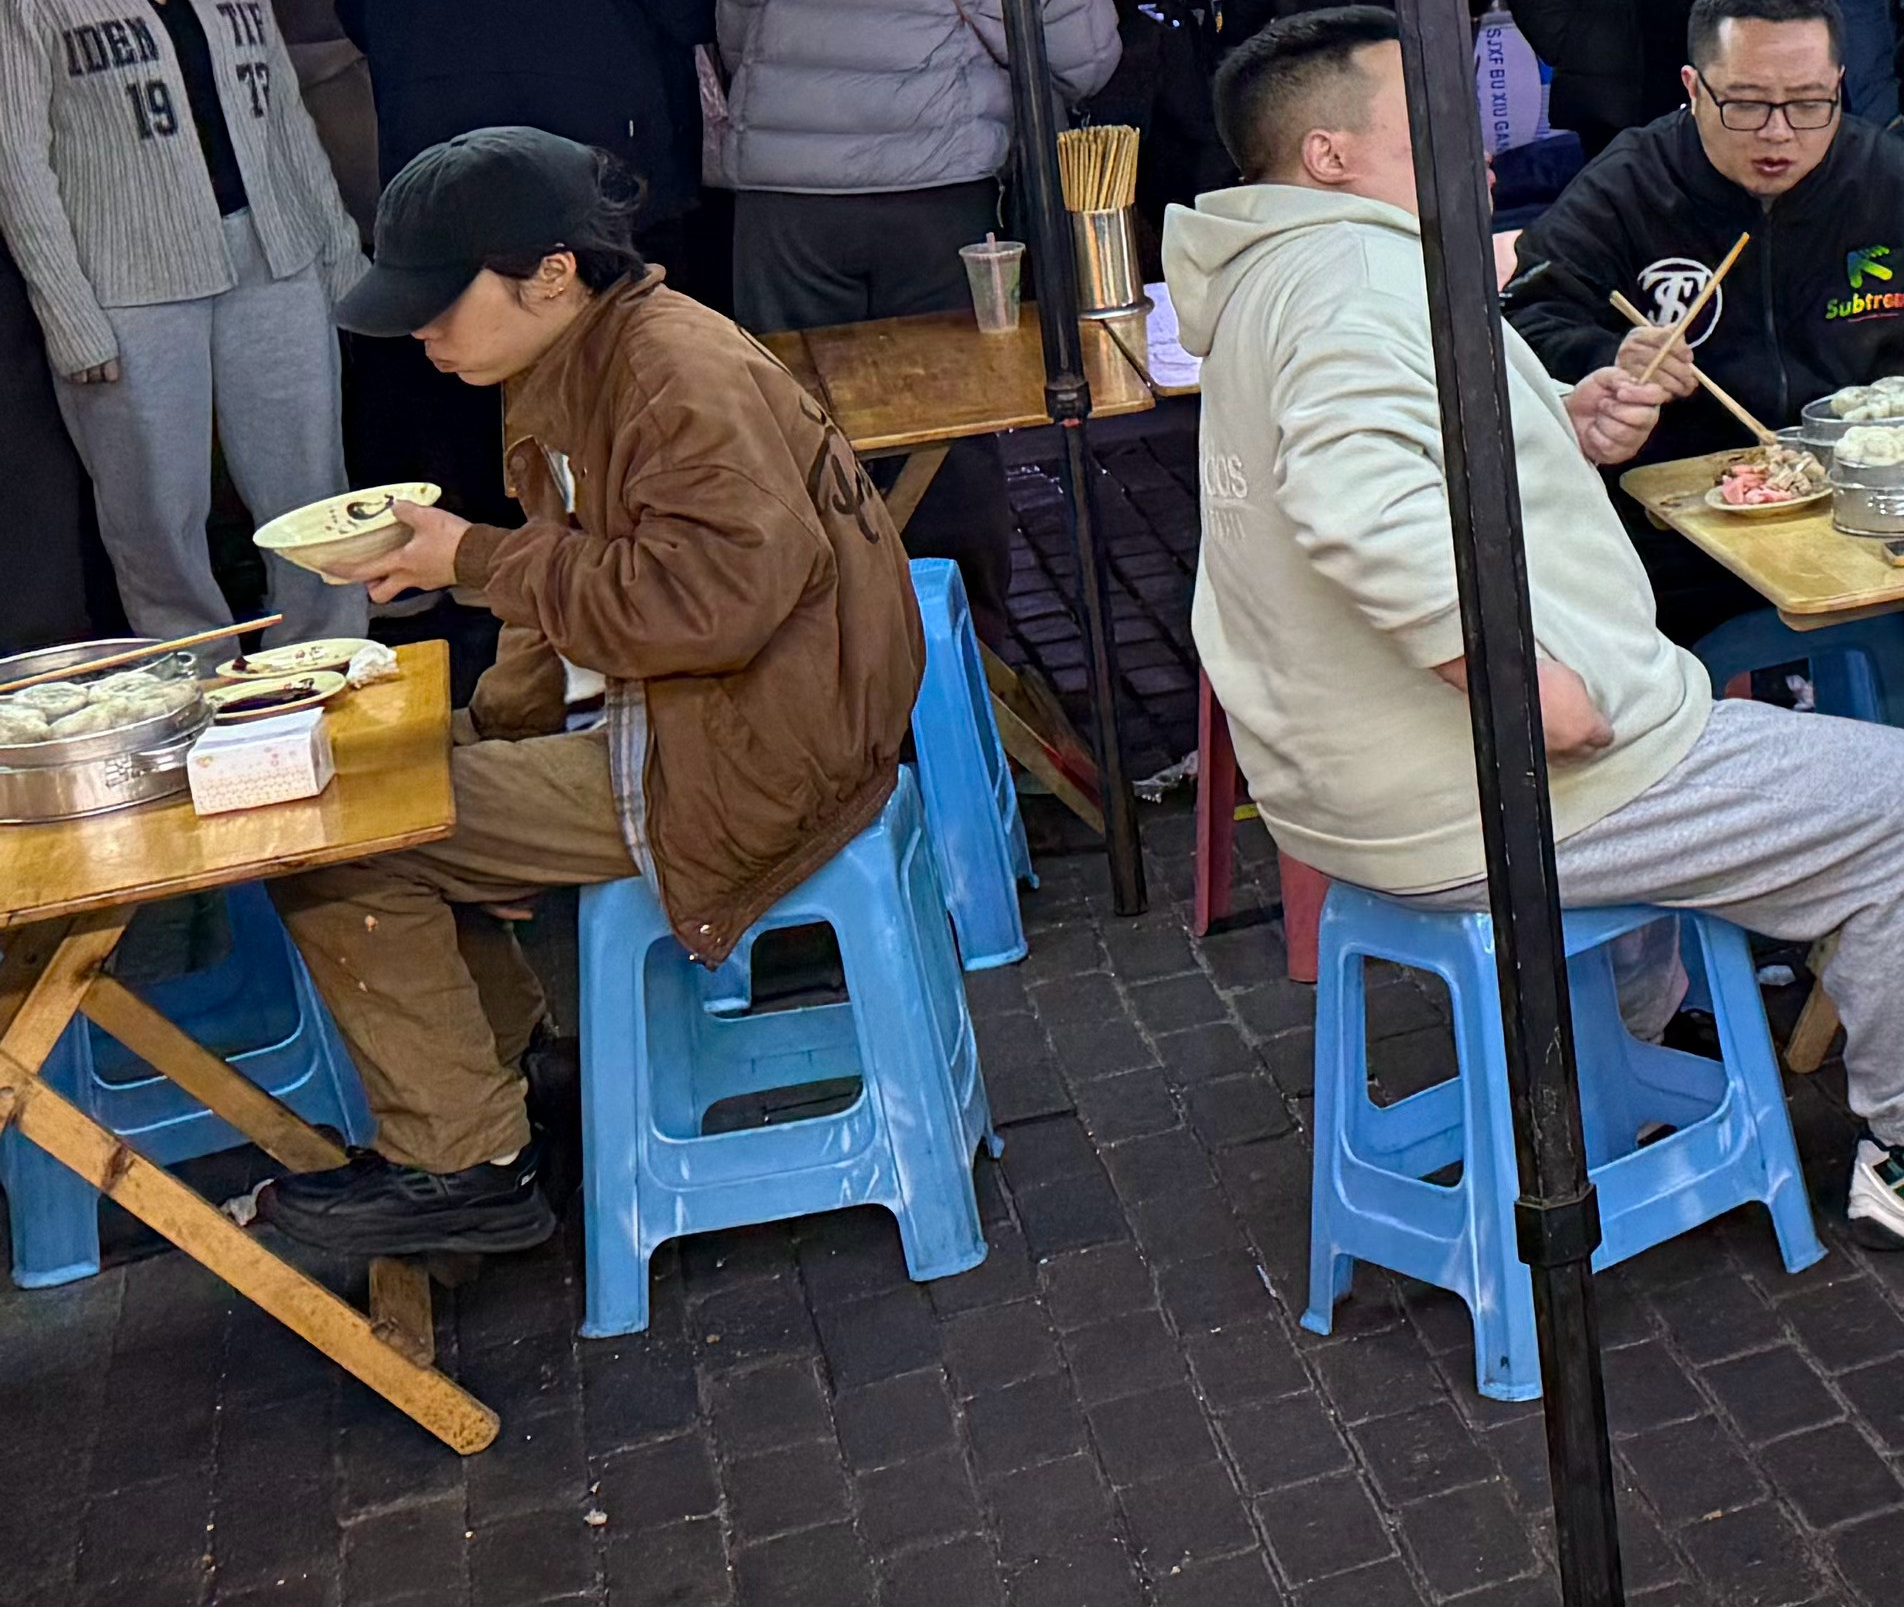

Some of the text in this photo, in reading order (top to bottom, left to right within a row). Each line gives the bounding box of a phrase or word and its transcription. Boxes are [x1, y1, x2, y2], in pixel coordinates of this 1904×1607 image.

[63, 16, 160, 77] IDEN
[1490, 68, 1505, 90] BU
[125, 78, 178, 140] 19
[1491, 93, 1508, 117] XIU
